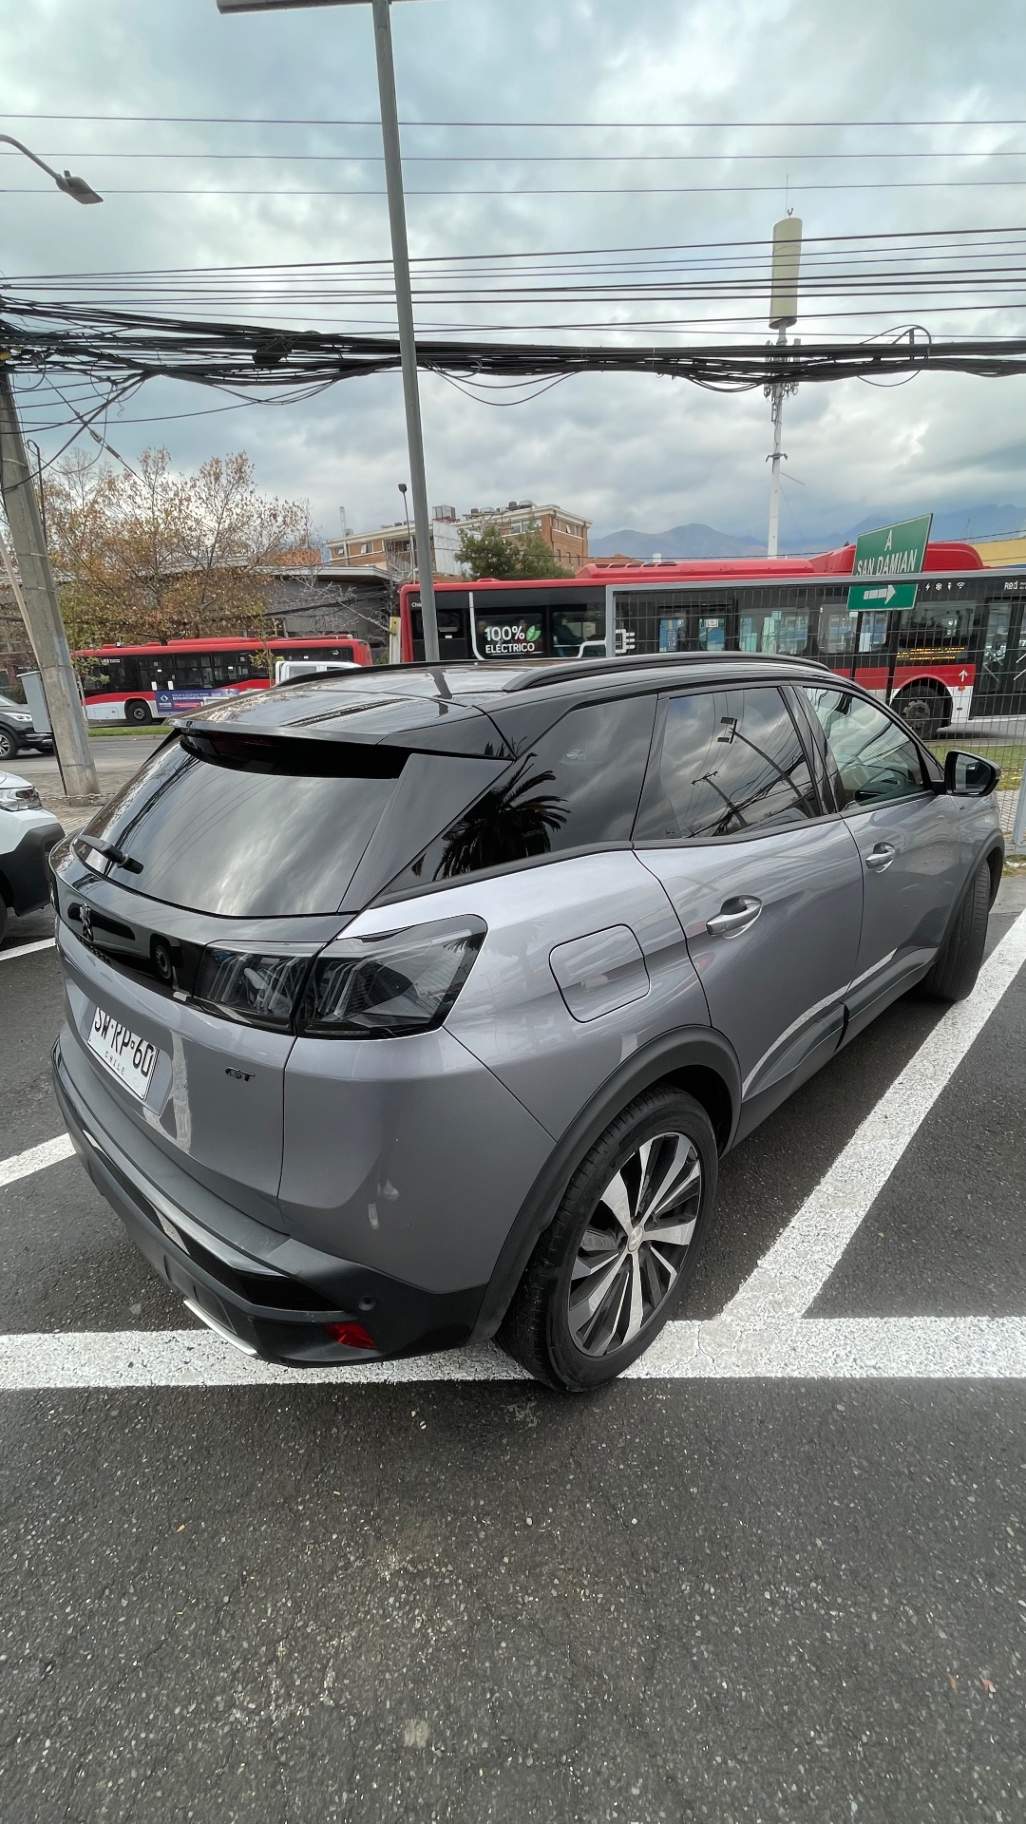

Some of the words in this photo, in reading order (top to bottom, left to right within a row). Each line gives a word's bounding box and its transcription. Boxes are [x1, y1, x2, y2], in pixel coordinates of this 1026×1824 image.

[884, 529, 893, 551] A
[856, 557, 875, 577] SAN
[876, 549, 918, 576] DAMIAN
[484, 625, 526, 641] 100%
[485, 641, 535, 654] ELÉCTRICO
[225, 1067, 256, 1082] GT
